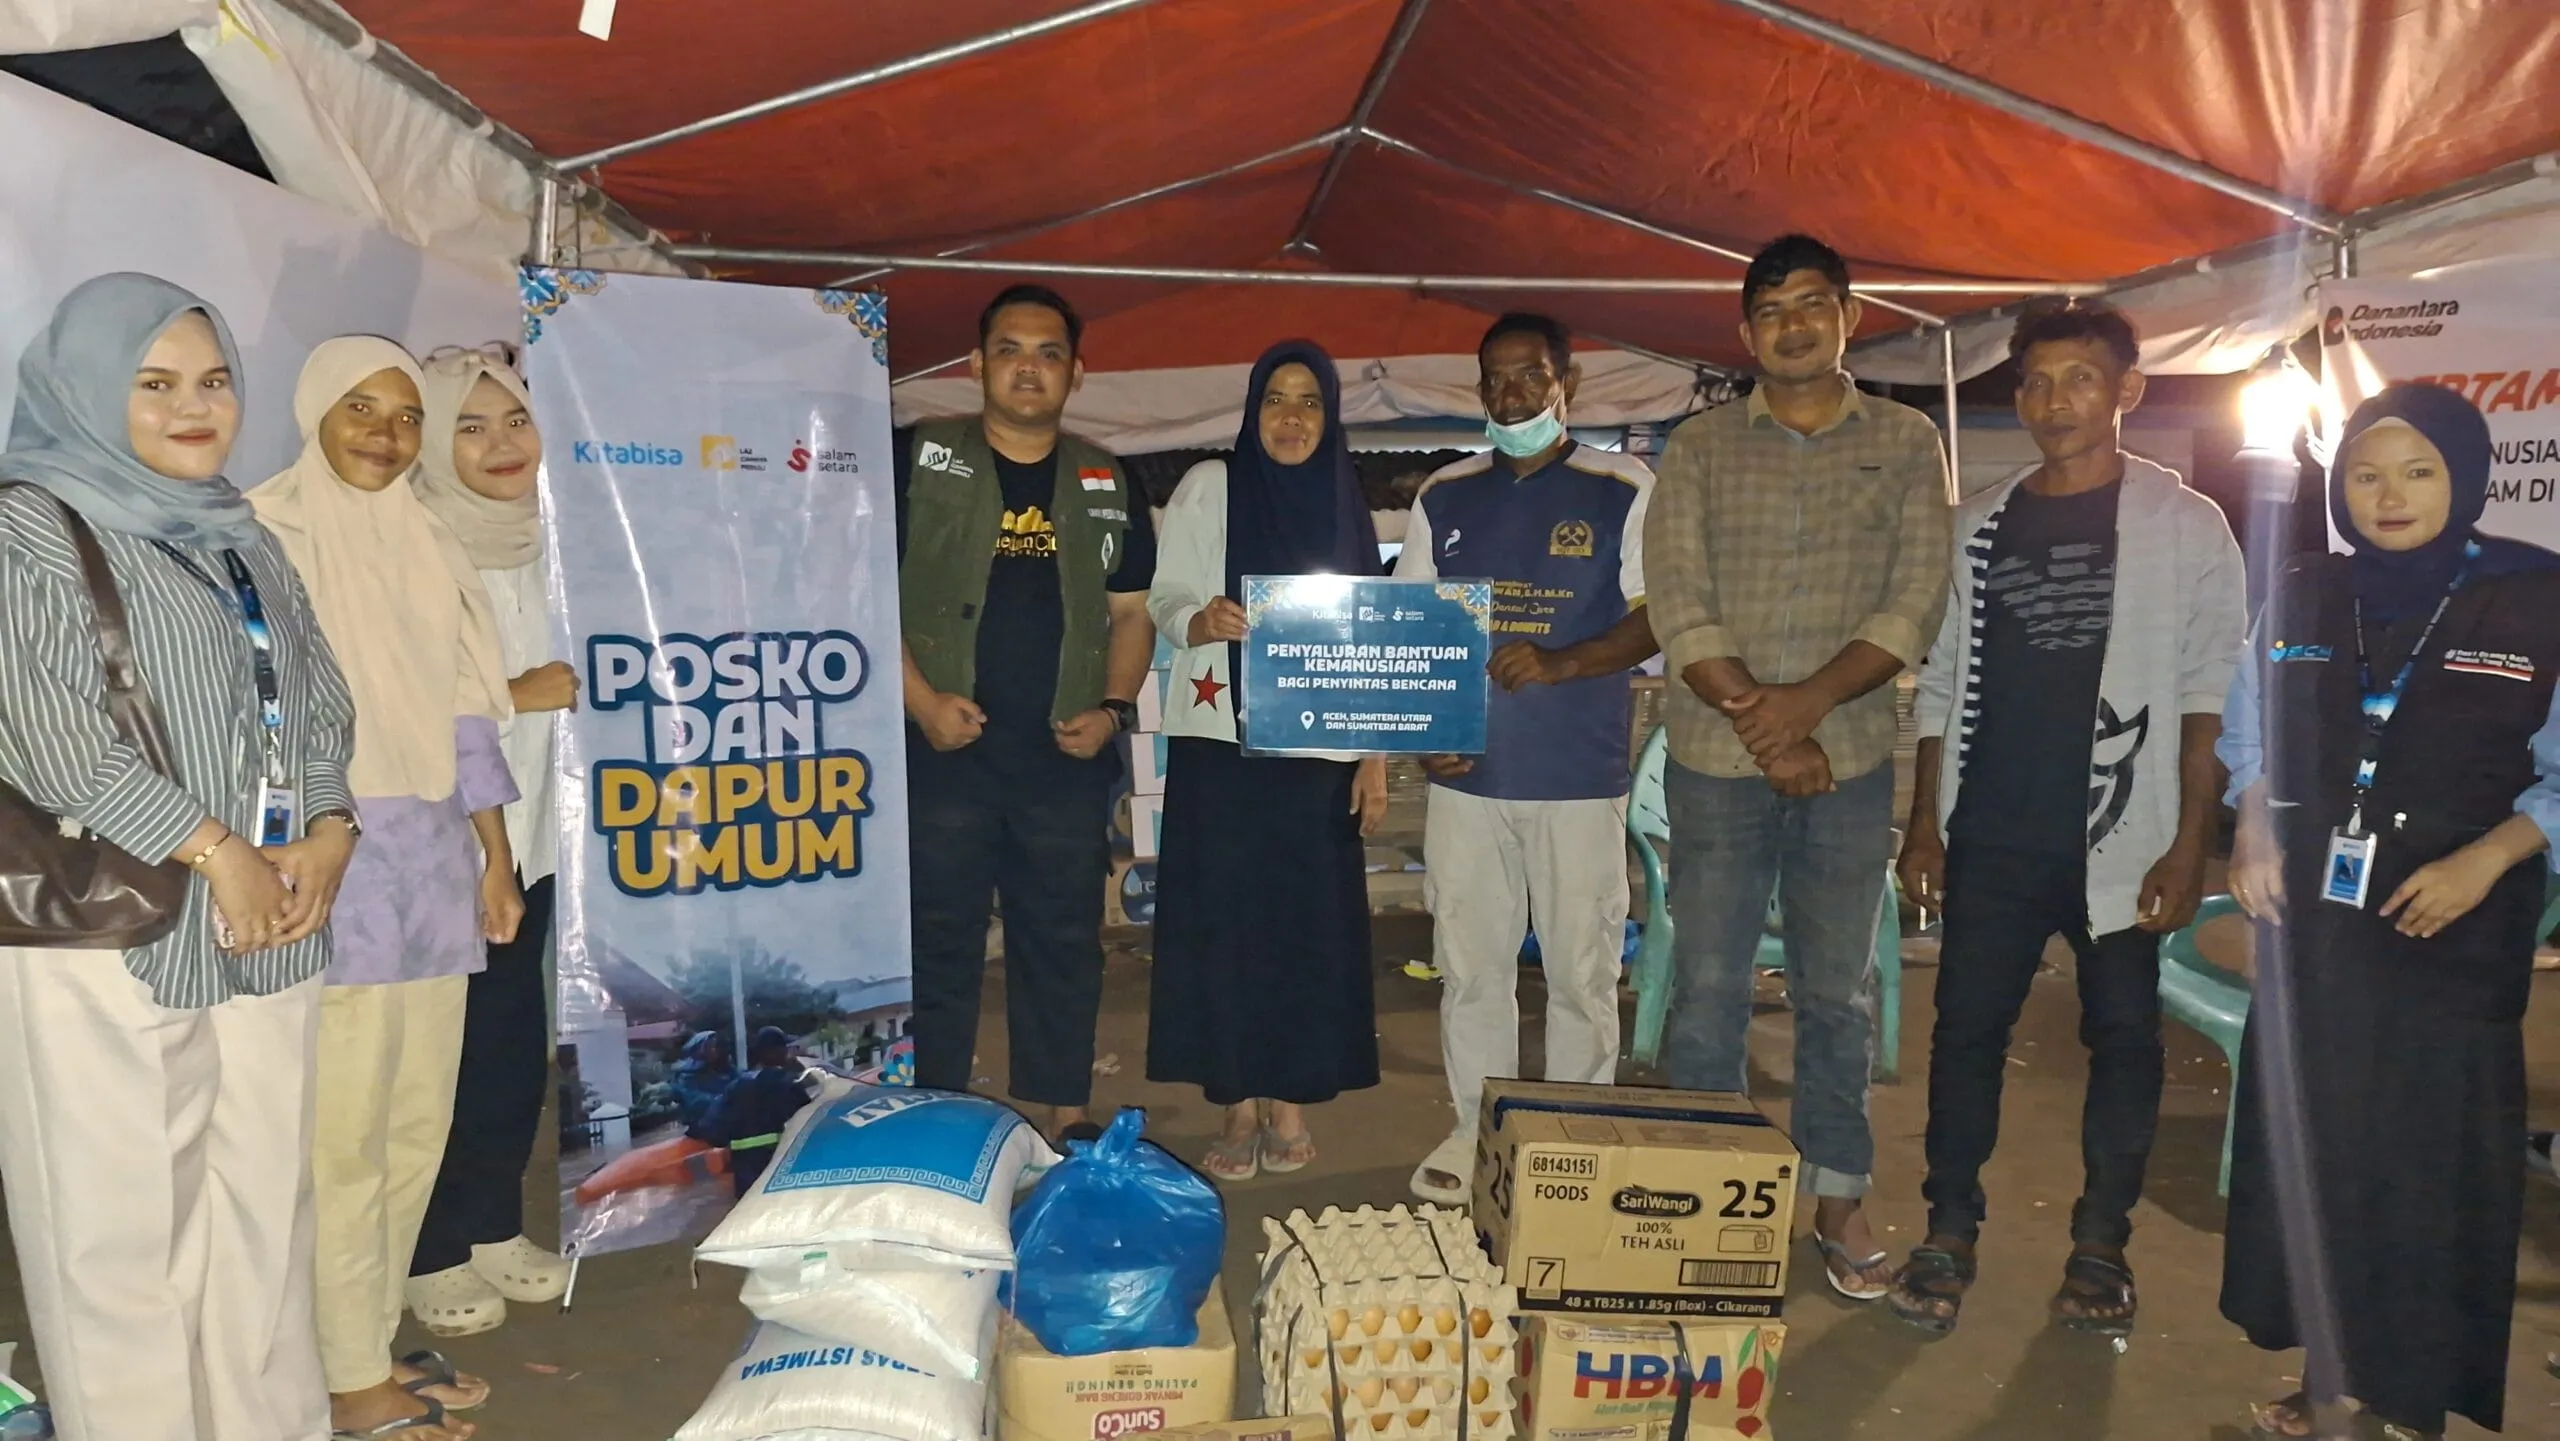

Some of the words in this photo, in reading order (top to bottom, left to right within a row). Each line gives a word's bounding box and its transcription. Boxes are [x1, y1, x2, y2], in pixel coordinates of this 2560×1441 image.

[2350, 300, 2460, 321] Danantara
[2348, 321, 2443, 341] ndonesia
[818, 449, 857, 461] salam
[818, 462, 859, 474] setara
[2529, 478, 2555, 502] DI
[1267, 643, 1381, 659] PENYALURAN
[1384, 645, 1468, 660] BANTUAN
[593, 637, 864, 702] POSKO
[1304, 658, 1430, 673] KEMANUSIAAN
[1278, 677, 1310, 689] BAGI
[1313, 678, 1389, 690] PENYINTAS
[1392, 679, 1457, 691] BENCANA
[1322, 712, 1349, 722] ACEH,
[1351, 712, 1399, 722] SUMATERA
[1401, 713, 1432, 722] UTARA
[1326, 721, 1345, 730] DAN
[1347, 721, 1396, 731] SUMATERA
[1398, 722, 1428, 731] BARAT
[652, 700, 816, 763] DAN
[601, 756, 867, 827] DAPUR
[616, 815, 856, 889] UMUM
[1532, 1156, 1594, 1175] 68143151
[1534, 1184, 1589, 1202] FOODS
[1718, 1179, 1778, 1219] 25
[1620, 1193, 1693, 1213] SariWangi
[1635, 1221, 1673, 1235] 100%
[1620, 1235, 1649, 1250] TEH
[1653, 1237, 1685, 1251] ASLI
[1536, 1261, 1556, 1288] 7
[1565, 1296, 1582, 1308] 48
[1583, 1300, 1591, 1309] x
[1593, 1298, 1625, 1310] TB25
[1627, 1301, 1635, 1310] x
[1638, 1299, 1672, 1313] 1.85g
[1674, 1299, 1706, 1313] (Box)
[1716, 1301, 1771, 1316] Cikarang
[740, 1346, 855, 1382] ISTIMEWA
[1143, 1378, 1198, 1389] PALING
[1574, 1351, 1722, 1400] HBM
[1066, 1379, 1135, 1393] BENING!!
[1145, 1390, 1184, 1401] MINYAK
[1097, 1409, 1161, 1436] SunCo
